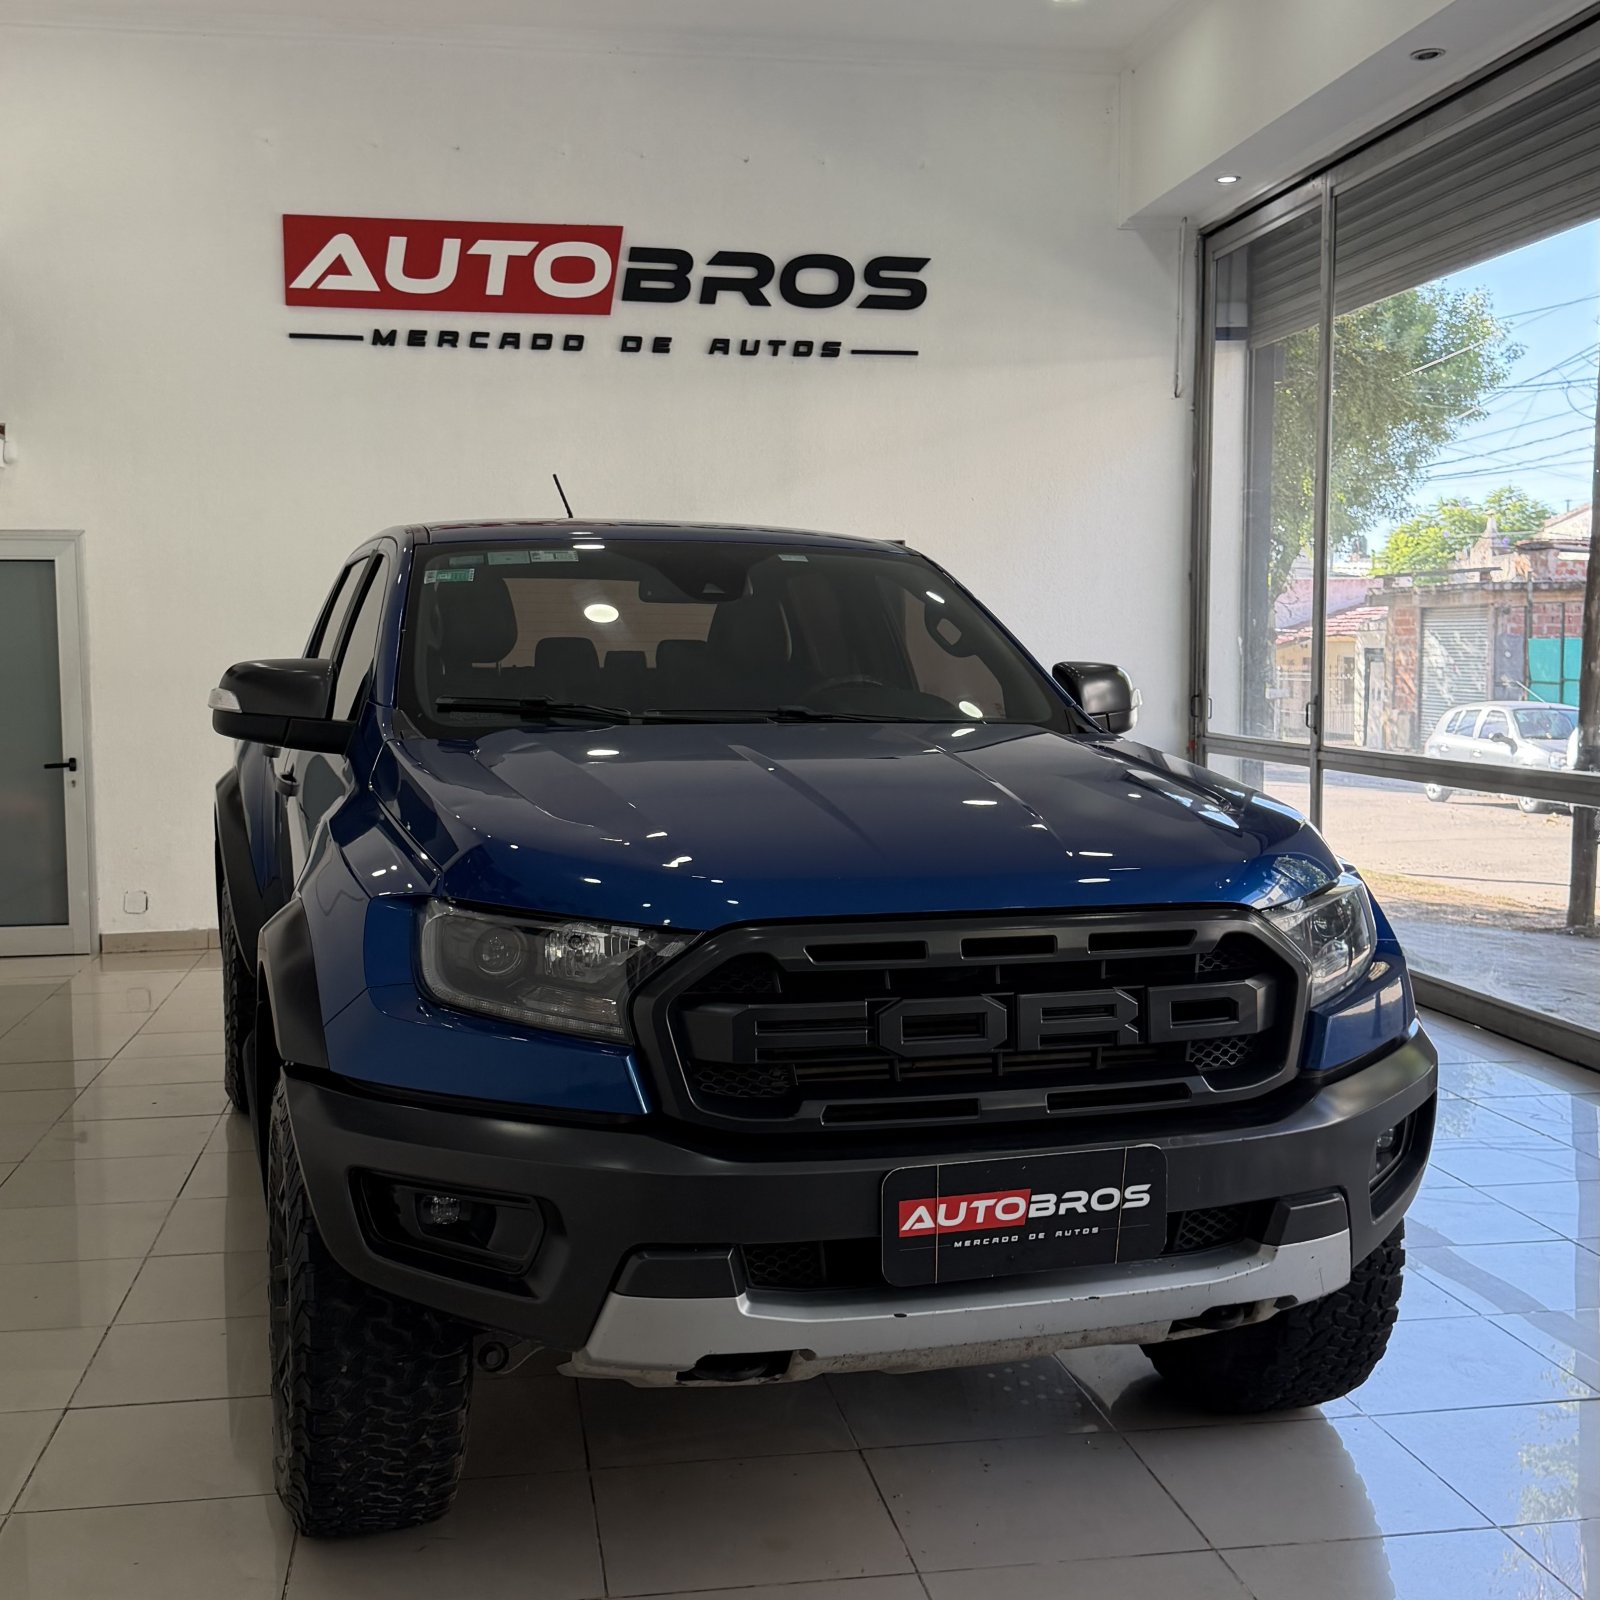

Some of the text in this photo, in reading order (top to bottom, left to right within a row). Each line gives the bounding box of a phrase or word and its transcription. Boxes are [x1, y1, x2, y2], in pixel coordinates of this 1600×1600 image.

[289, 233, 931, 310] AUTOBROS
[371, 328, 843, 357] MERCADO DE AUTOS
[692, 976, 1272, 1063] FORD
[901, 1183, 1152, 1231] AUTOBROS
[953, 1226, 1100, 1248] MERCADO DE AUTOS
